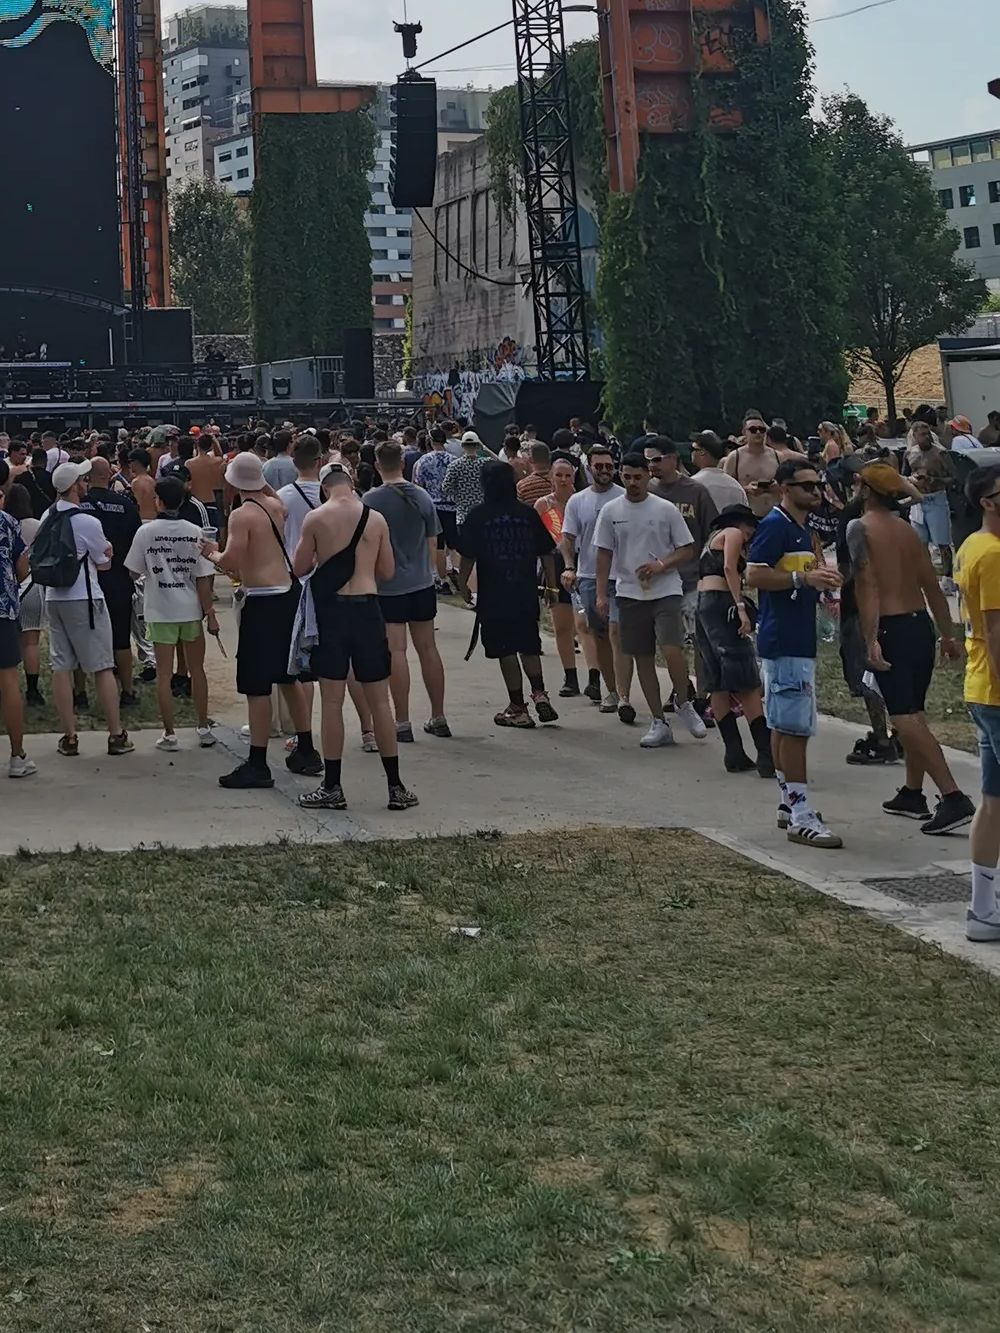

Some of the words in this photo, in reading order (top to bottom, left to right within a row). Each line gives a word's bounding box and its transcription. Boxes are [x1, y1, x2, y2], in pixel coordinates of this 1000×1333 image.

[154, 535, 198, 544] unexpected
[146, 546, 173, 555] rhythm
[151, 566, 164, 574] the
